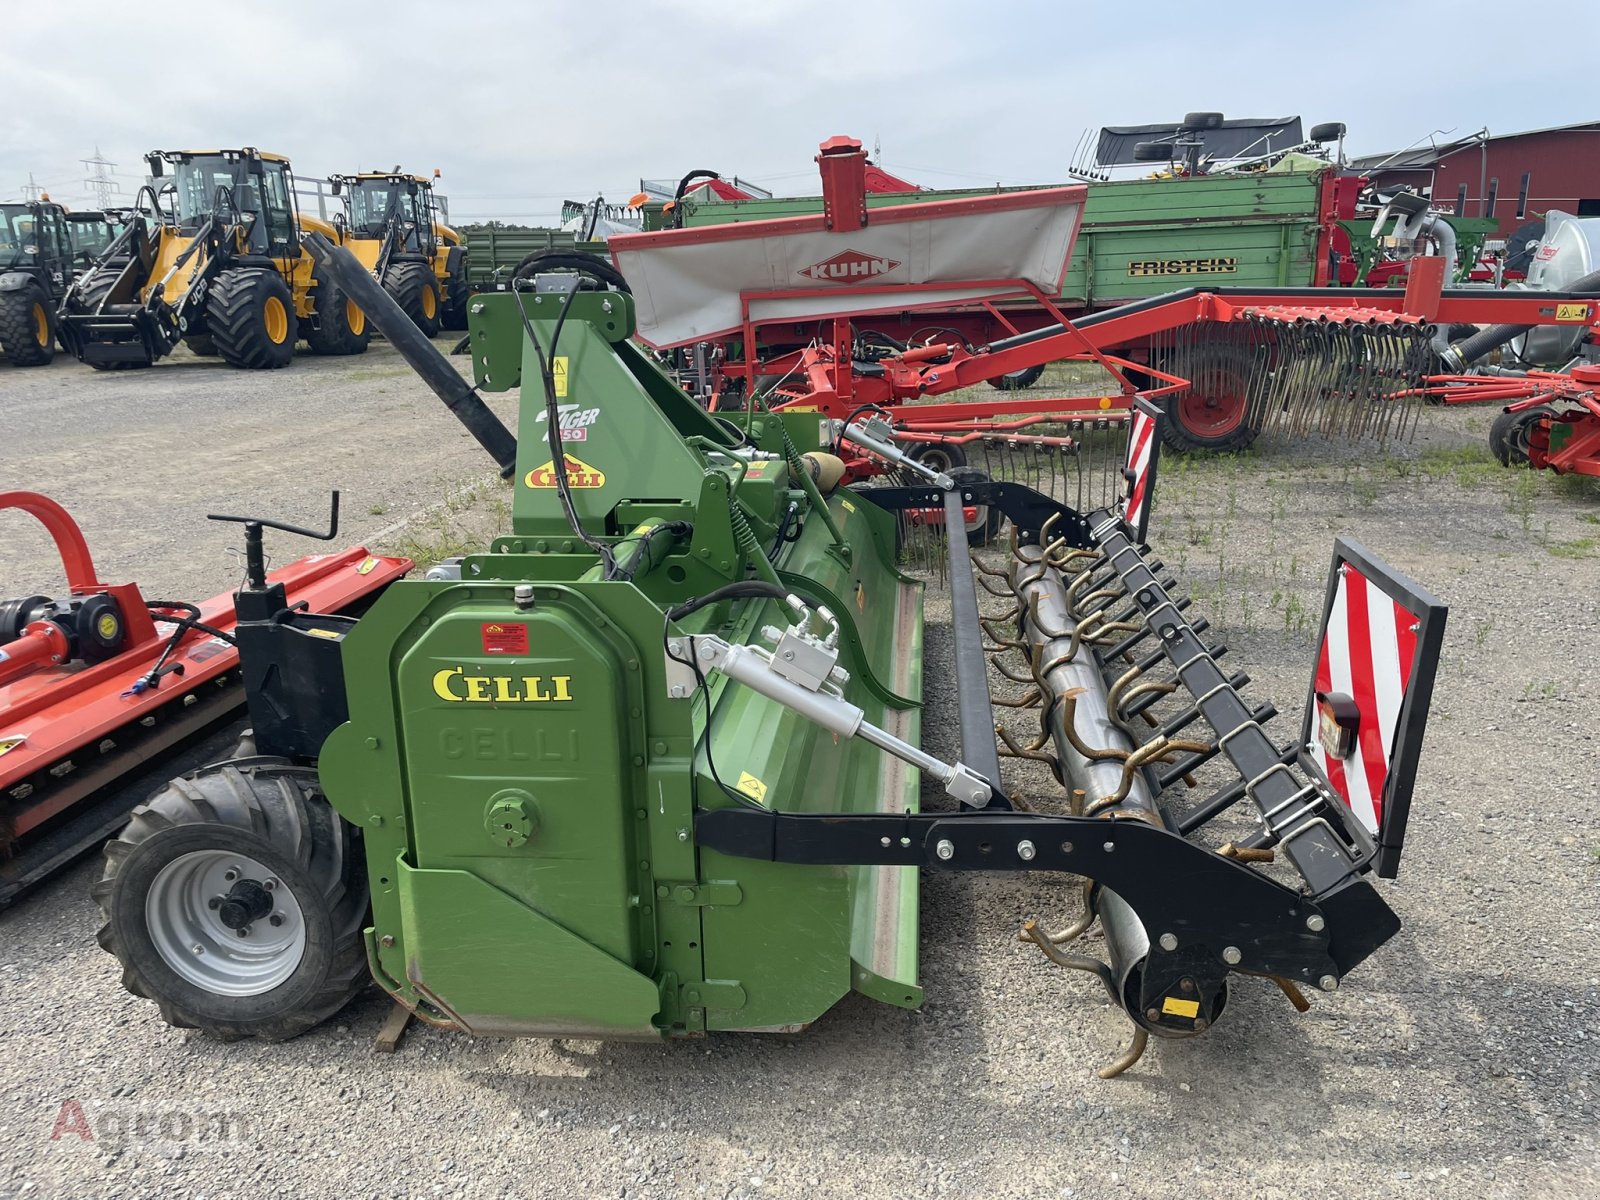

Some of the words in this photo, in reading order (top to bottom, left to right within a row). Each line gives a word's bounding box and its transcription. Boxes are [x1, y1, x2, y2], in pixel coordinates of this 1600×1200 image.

[810, 258, 889, 279] KUHN
[1129, 258, 1235, 275] FRISTEIN
[190, 278, 208, 306] JCB
[432, 666, 573, 702] CELLI
[439, 727, 580, 761] CELLI
